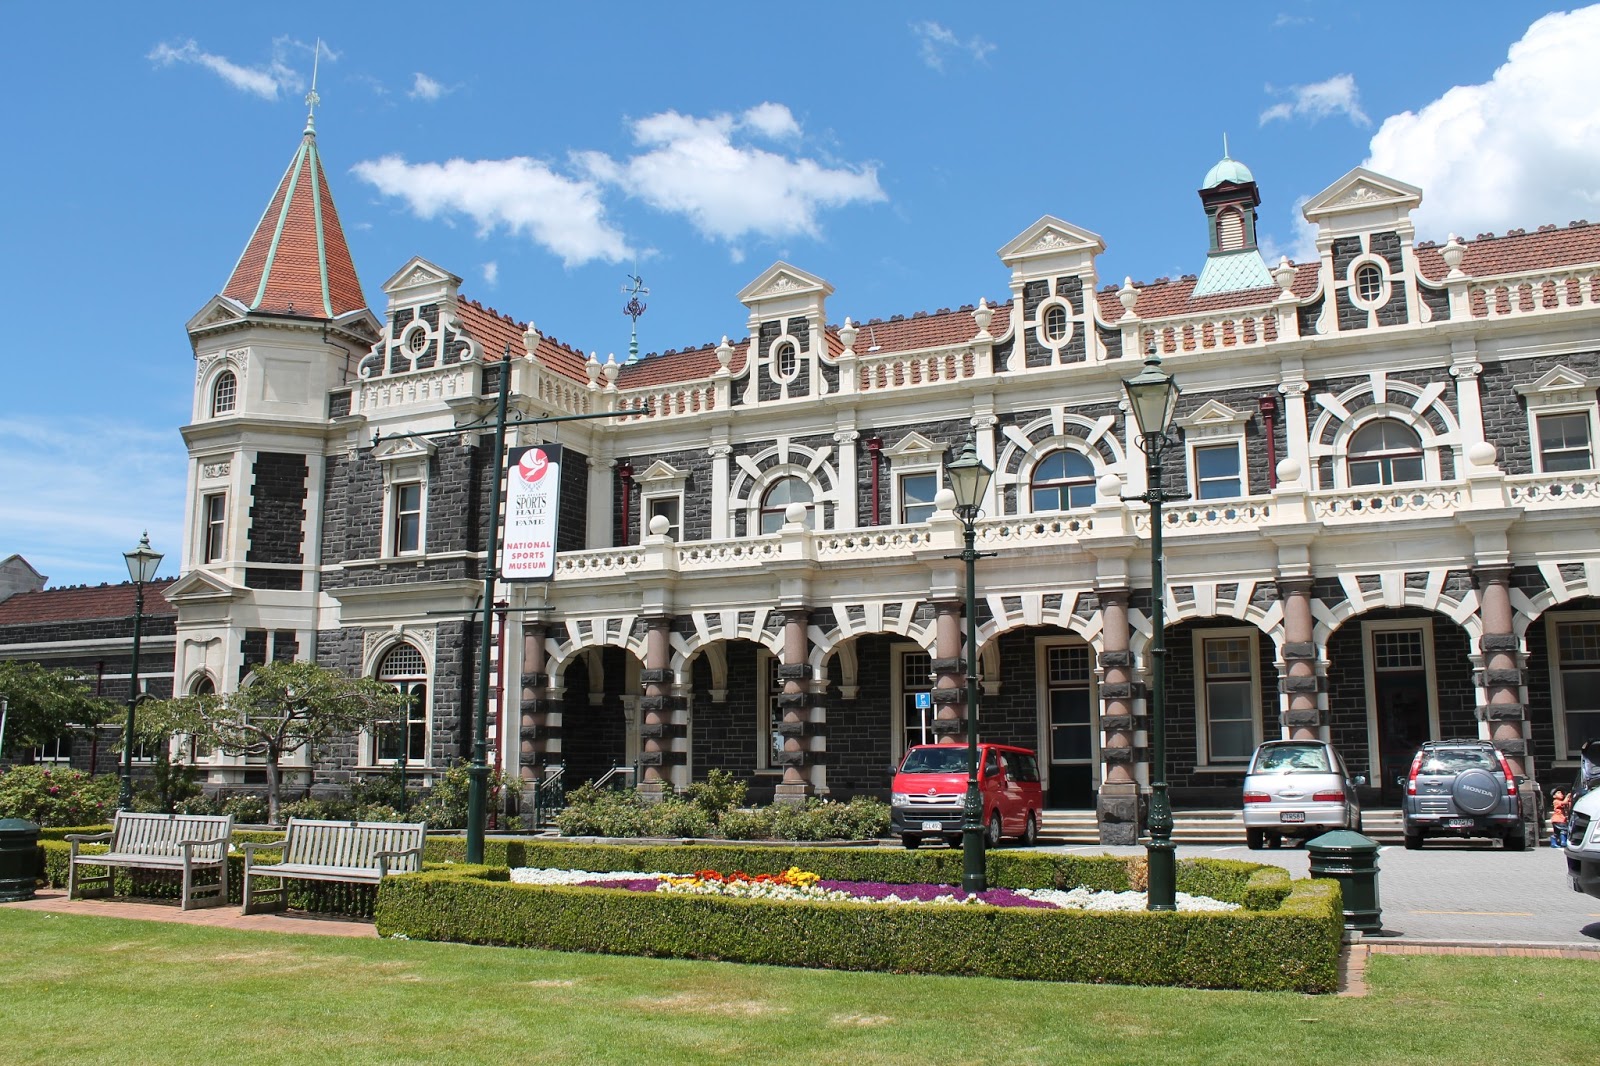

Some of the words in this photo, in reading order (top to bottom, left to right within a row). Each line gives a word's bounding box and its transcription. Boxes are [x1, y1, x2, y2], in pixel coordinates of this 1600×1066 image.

[516, 496, 547, 509] SPORTS
[507, 541, 551, 549] NATIONAL
[508, 562, 546, 570] MUSEUM
[1462, 784, 1493, 798] HONDA
